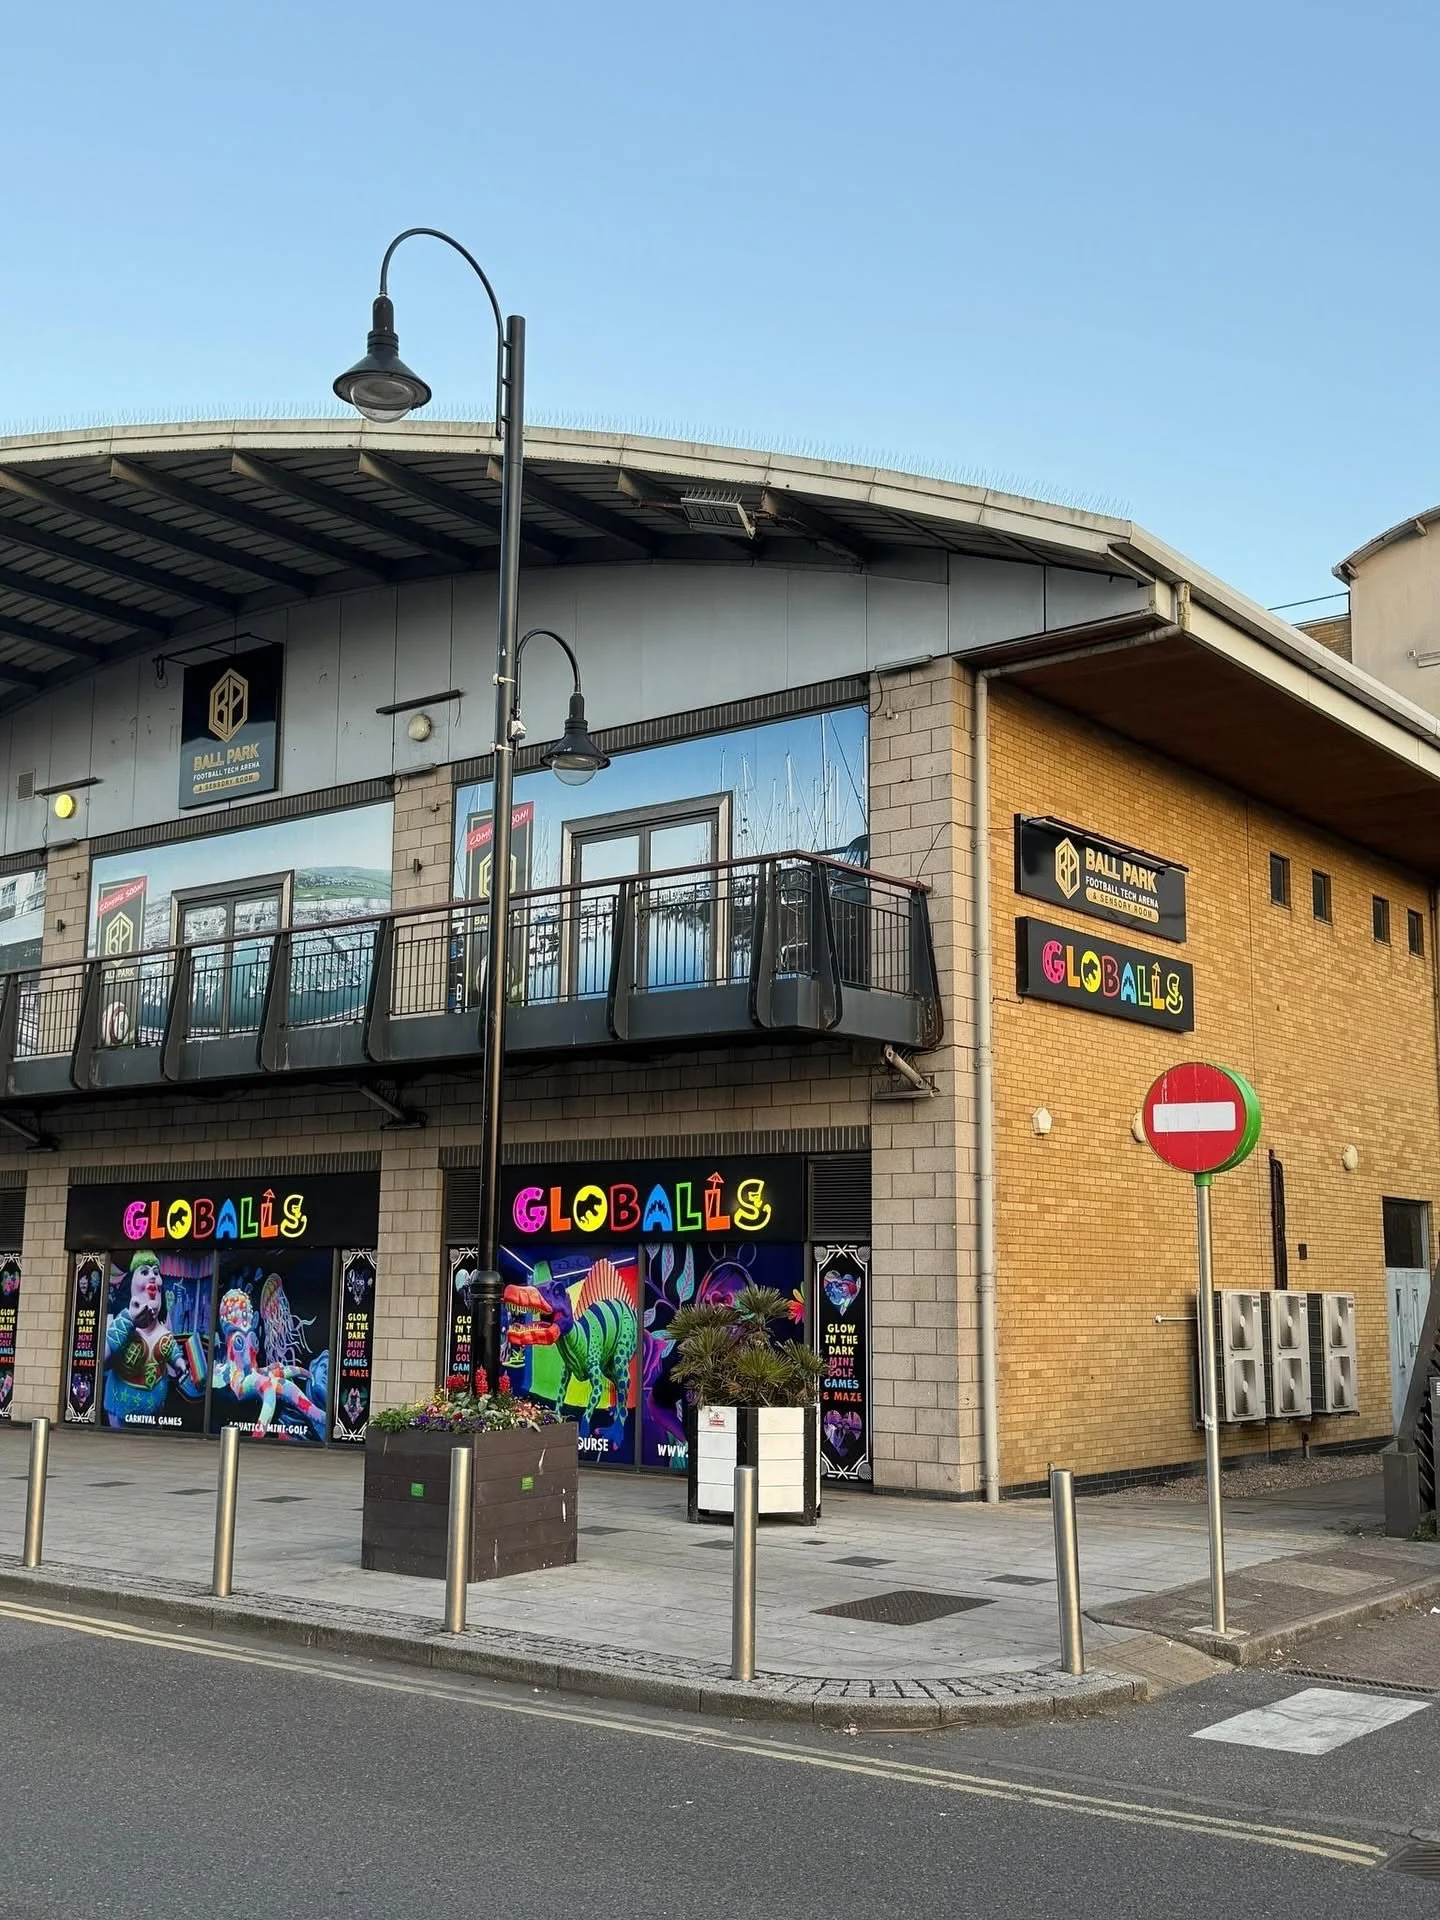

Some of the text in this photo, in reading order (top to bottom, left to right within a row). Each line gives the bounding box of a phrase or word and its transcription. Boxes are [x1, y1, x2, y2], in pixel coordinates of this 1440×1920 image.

[194, 742, 260, 771] BALL PARK
[193, 760, 260, 781] FOOTBALL TECH ARENA
[1085, 847, 1158, 894] BALL PARK
[1085, 876, 1159, 909] FOOTBALL TECH ARENA
[99, 893, 124, 912] COMING
[1100, 894, 1133, 912] SENSORY
[1133, 904, 1152, 918] ROOM
[117, 968, 134, 978] PARK
[1042, 940, 1184, 1014] GLOBALLS
[512, 1172, 772, 1234] GLOBALLS
[123, 1189, 308, 1241] GLOBALLS
[79, 1310, 95, 1318] GLOW
[347, 1313, 368, 1321] GLOW
[456, 1316, 472, 1324] GLO
[455, 1325, 464, 1333] IN
[827, 1324, 856, 1334] GLOW
[825, 1335, 858, 1344] IN THE
[346, 1350, 366, 1358] GOLF,
[828, 1346, 854, 1355] DARK
[453, 1362, 470, 1371] GAM
[829, 1357, 854, 1366] MINI
[828, 1368, 855, 1378] GOLF,
[824, 1379, 859, 1389] GAMES
[834, 1392, 862, 1402] MAZE
[125, 1414, 182, 1426] CARNIVAL GAMES
[266, 1424, 308, 1435] MINI-GOLF
[578, 1436, 609, 1451] OURSE
